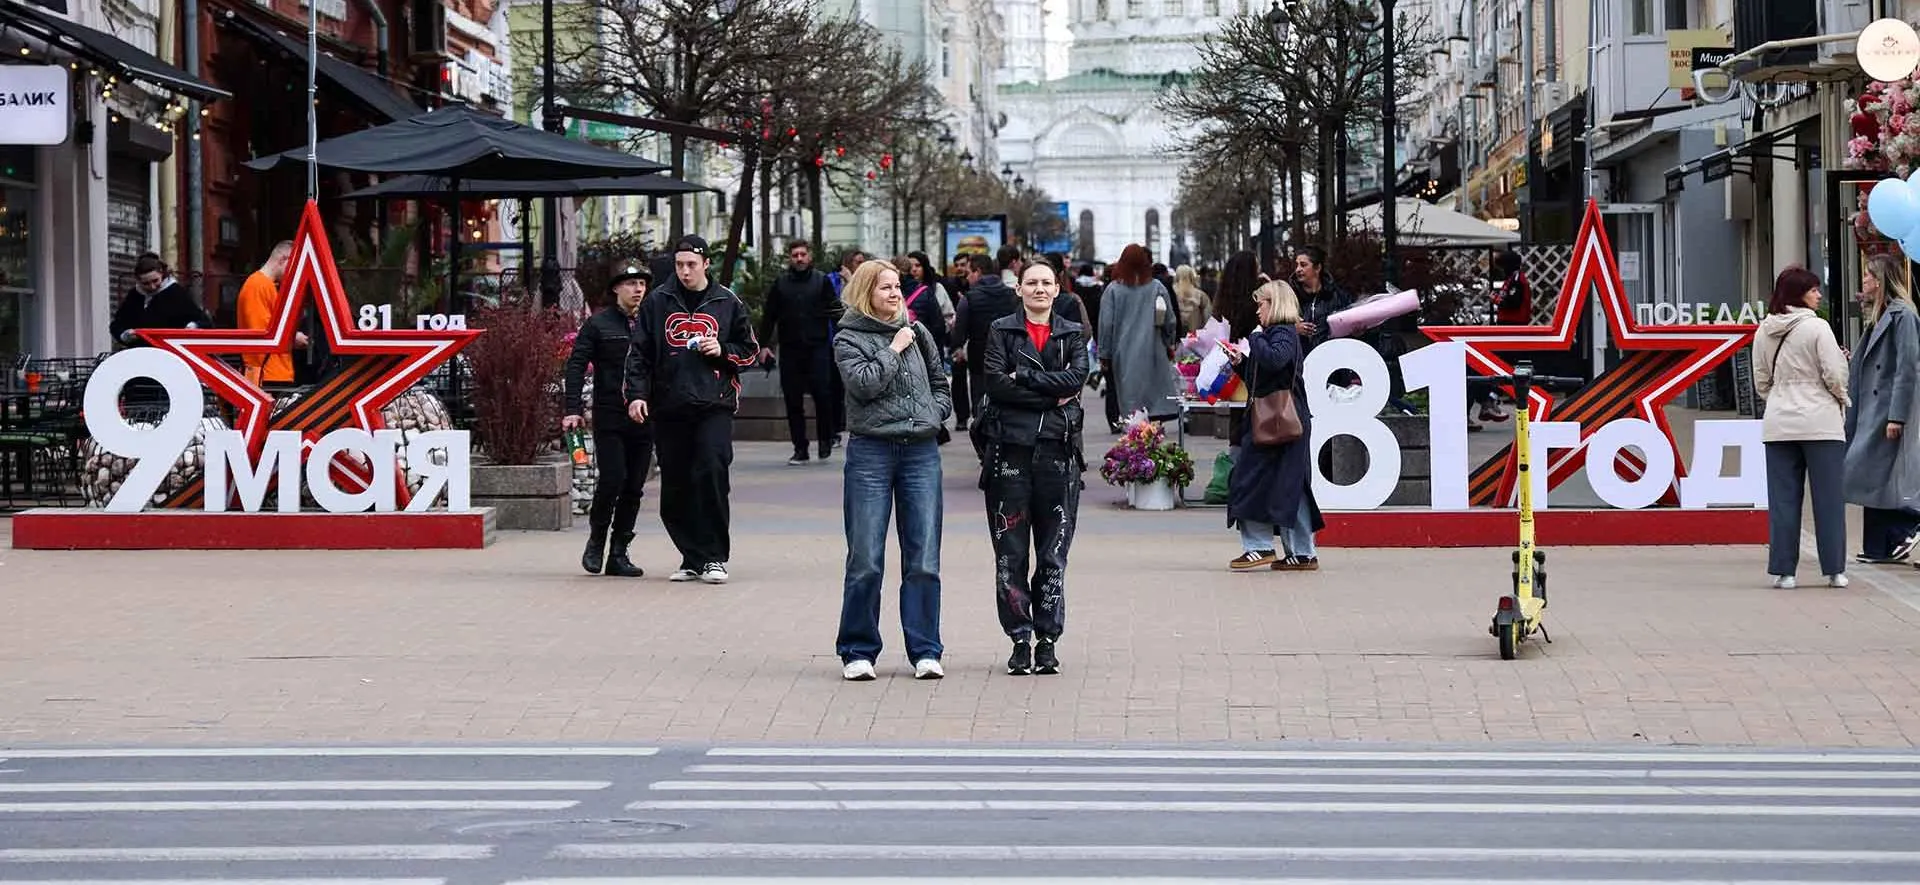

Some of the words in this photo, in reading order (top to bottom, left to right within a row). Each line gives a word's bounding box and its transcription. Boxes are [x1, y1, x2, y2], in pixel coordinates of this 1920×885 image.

[1700, 53, 1723, 65] Мир
[358, 304, 392, 331] 81
[416, 314, 467, 331] год
[1636, 301, 1764, 326] ПОБЕДА!
[83, 347, 203, 512] 9
[1302, 338, 1469, 510] 81
[1526, 418, 1768, 509] год
